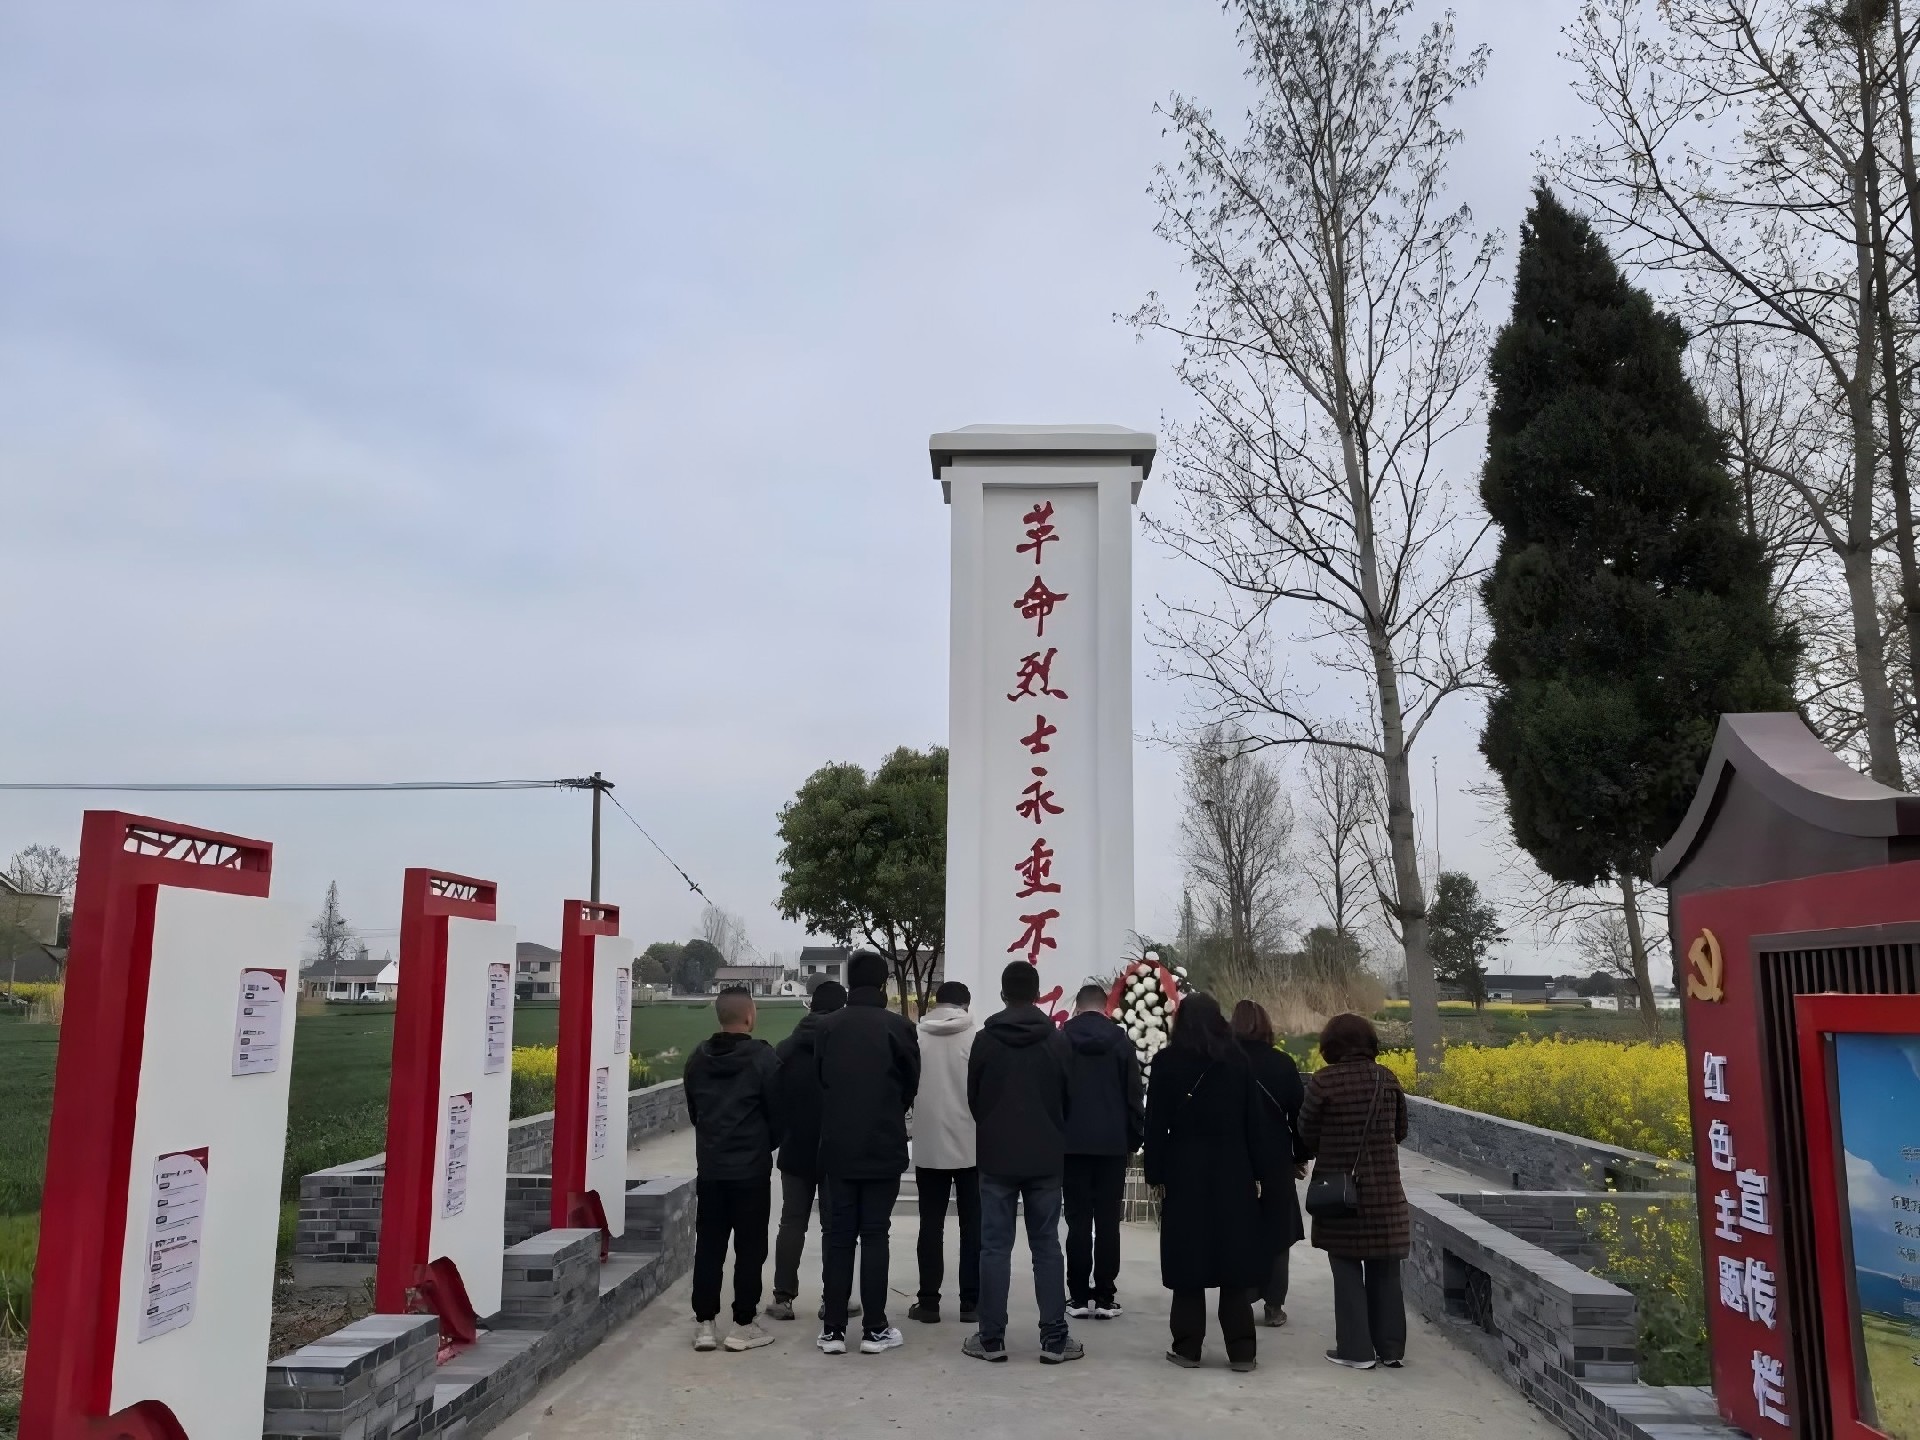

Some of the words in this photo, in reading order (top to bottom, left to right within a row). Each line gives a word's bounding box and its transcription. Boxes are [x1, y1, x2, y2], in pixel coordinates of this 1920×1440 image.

[1703, 1051, 1746, 1313] 红色主题
[1736, 1168, 1789, 1426] 宣传栏
